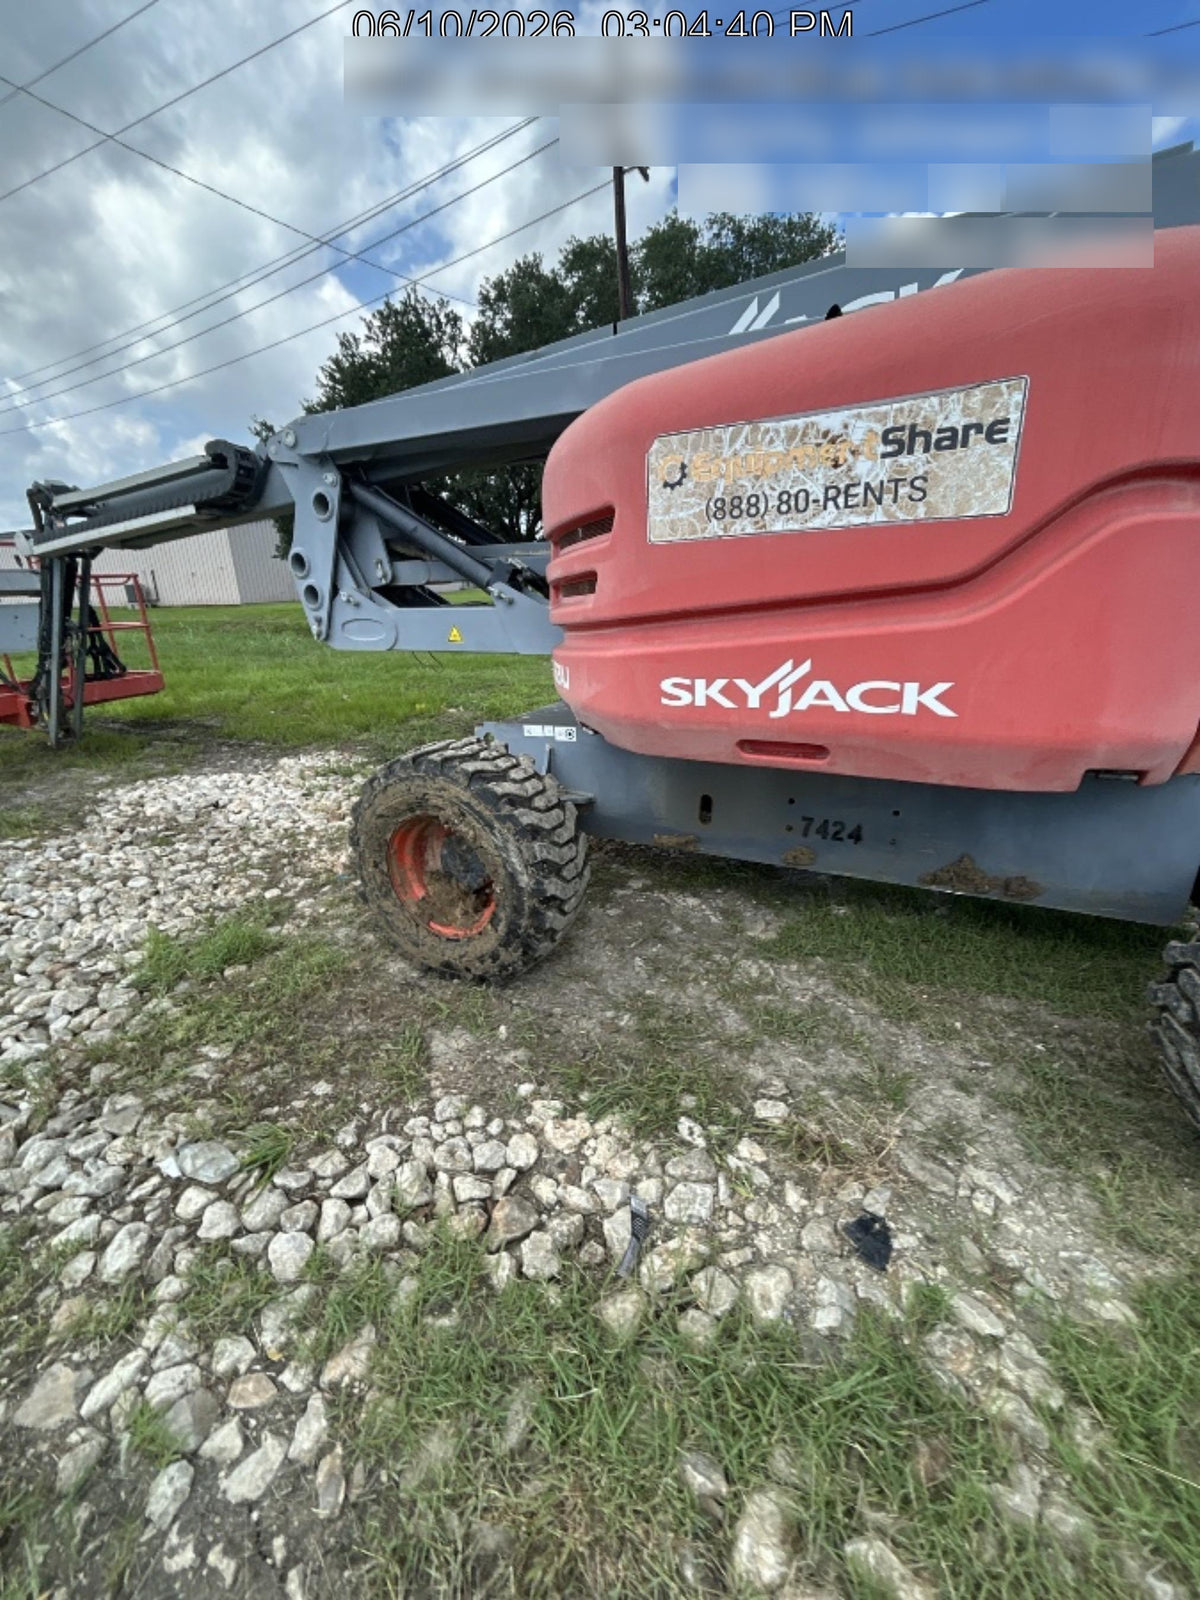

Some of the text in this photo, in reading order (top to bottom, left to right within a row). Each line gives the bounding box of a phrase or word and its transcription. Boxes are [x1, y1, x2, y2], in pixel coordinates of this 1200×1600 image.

[705, 475, 929, 522] (888) 80-RENTS
[659, 658, 959, 719] SKYJACK
[801, 815, 863, 846] 7424
